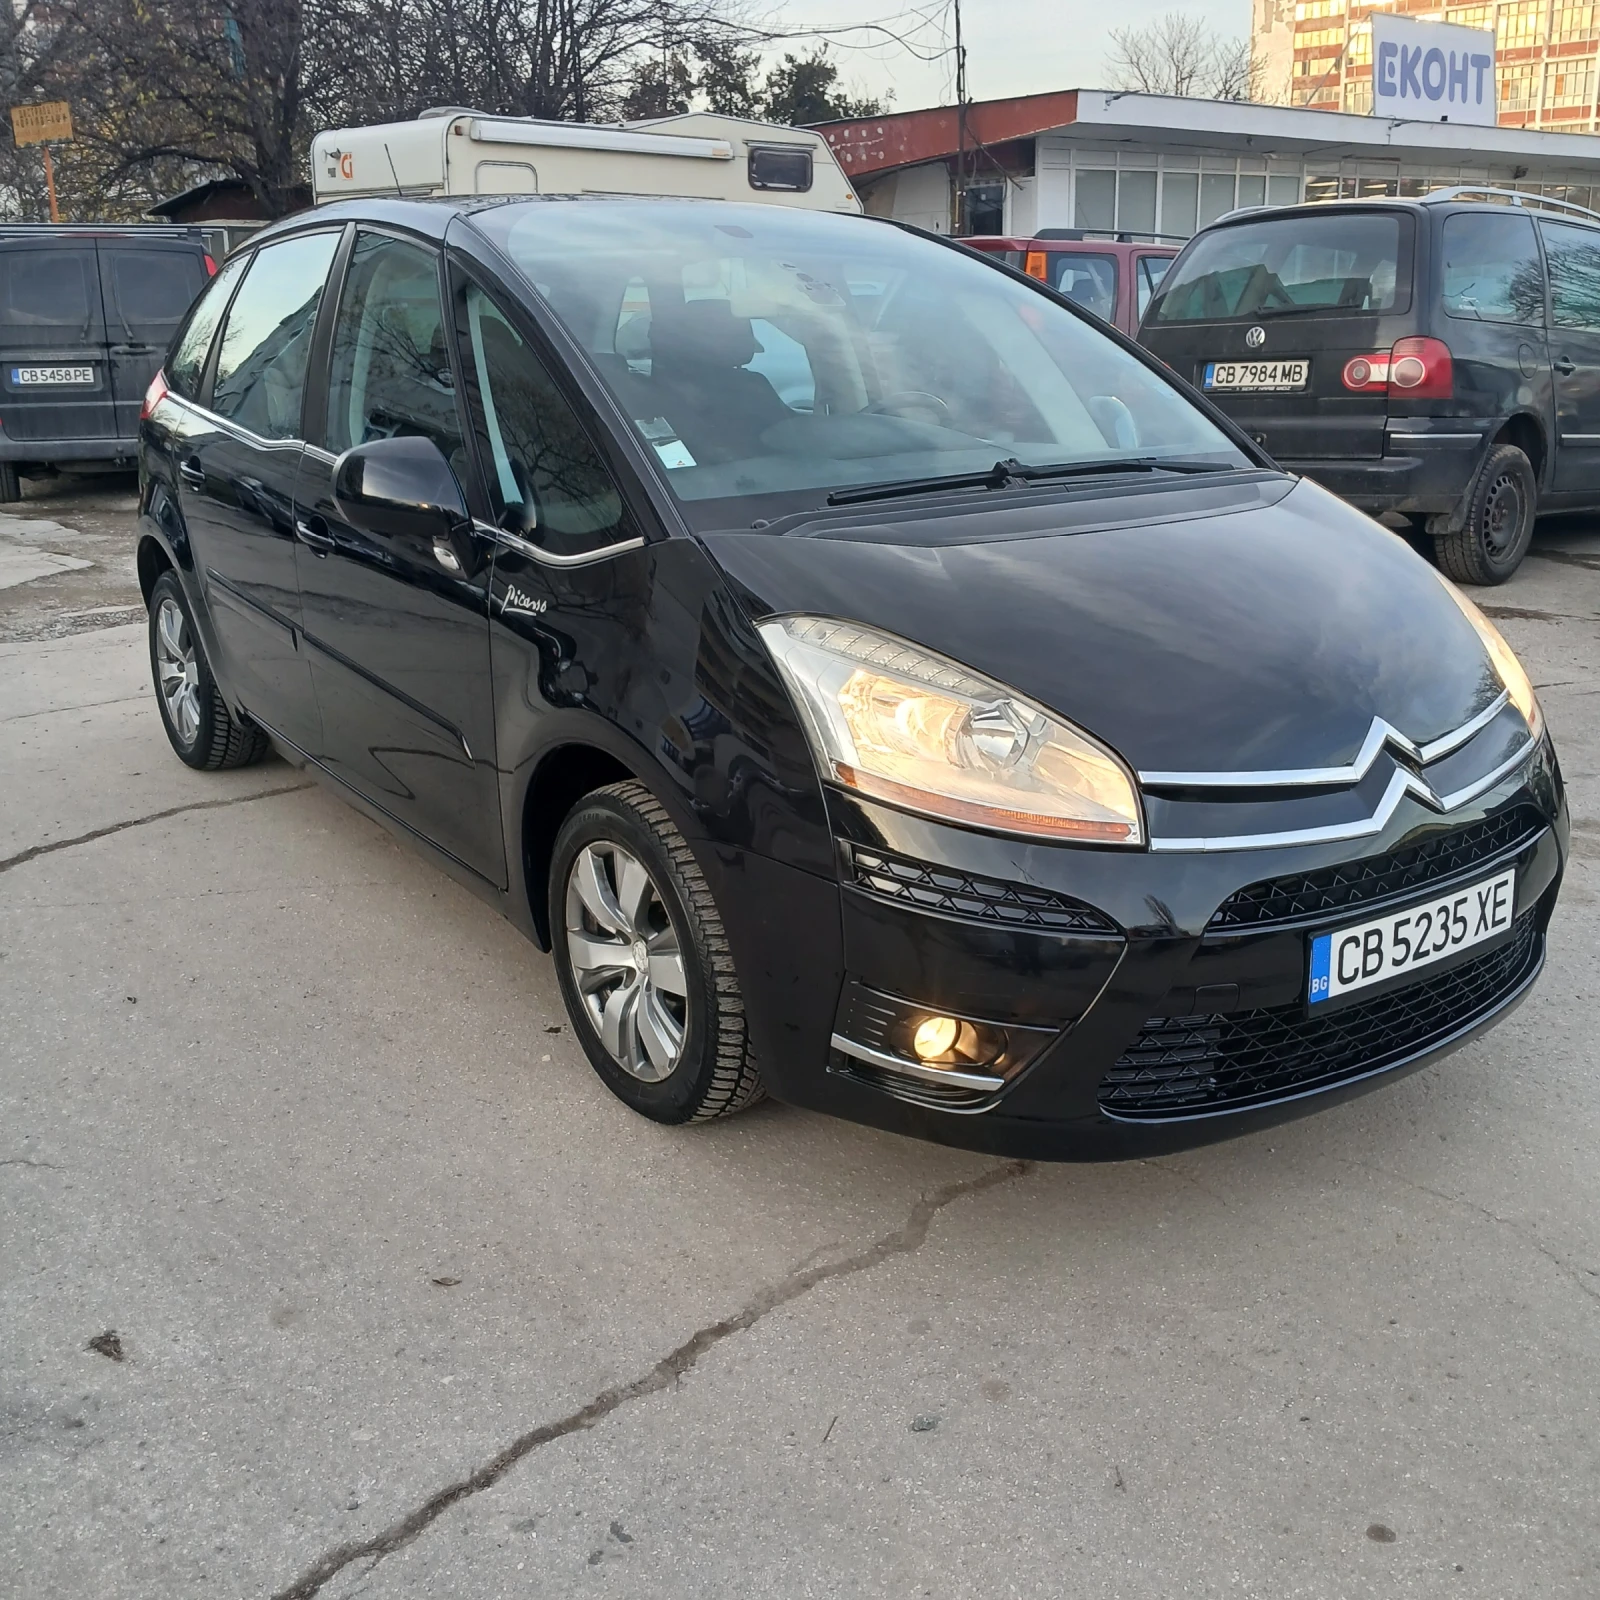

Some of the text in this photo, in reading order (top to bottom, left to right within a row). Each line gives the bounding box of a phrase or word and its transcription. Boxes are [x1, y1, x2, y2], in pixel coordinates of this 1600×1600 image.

[1377, 41, 1492, 105] ЕКОНТ
[21, 370, 39, 382] CB
[40, 369, 72, 382] 5458
[73, 369, 91, 381] PE
[1215, 364, 1303, 384] CB 7984 MB
[500, 583, 548, 614] Picasso
[1337, 878, 1509, 986] CB 5235 XE
[1311, 975, 1328, 994] BG
